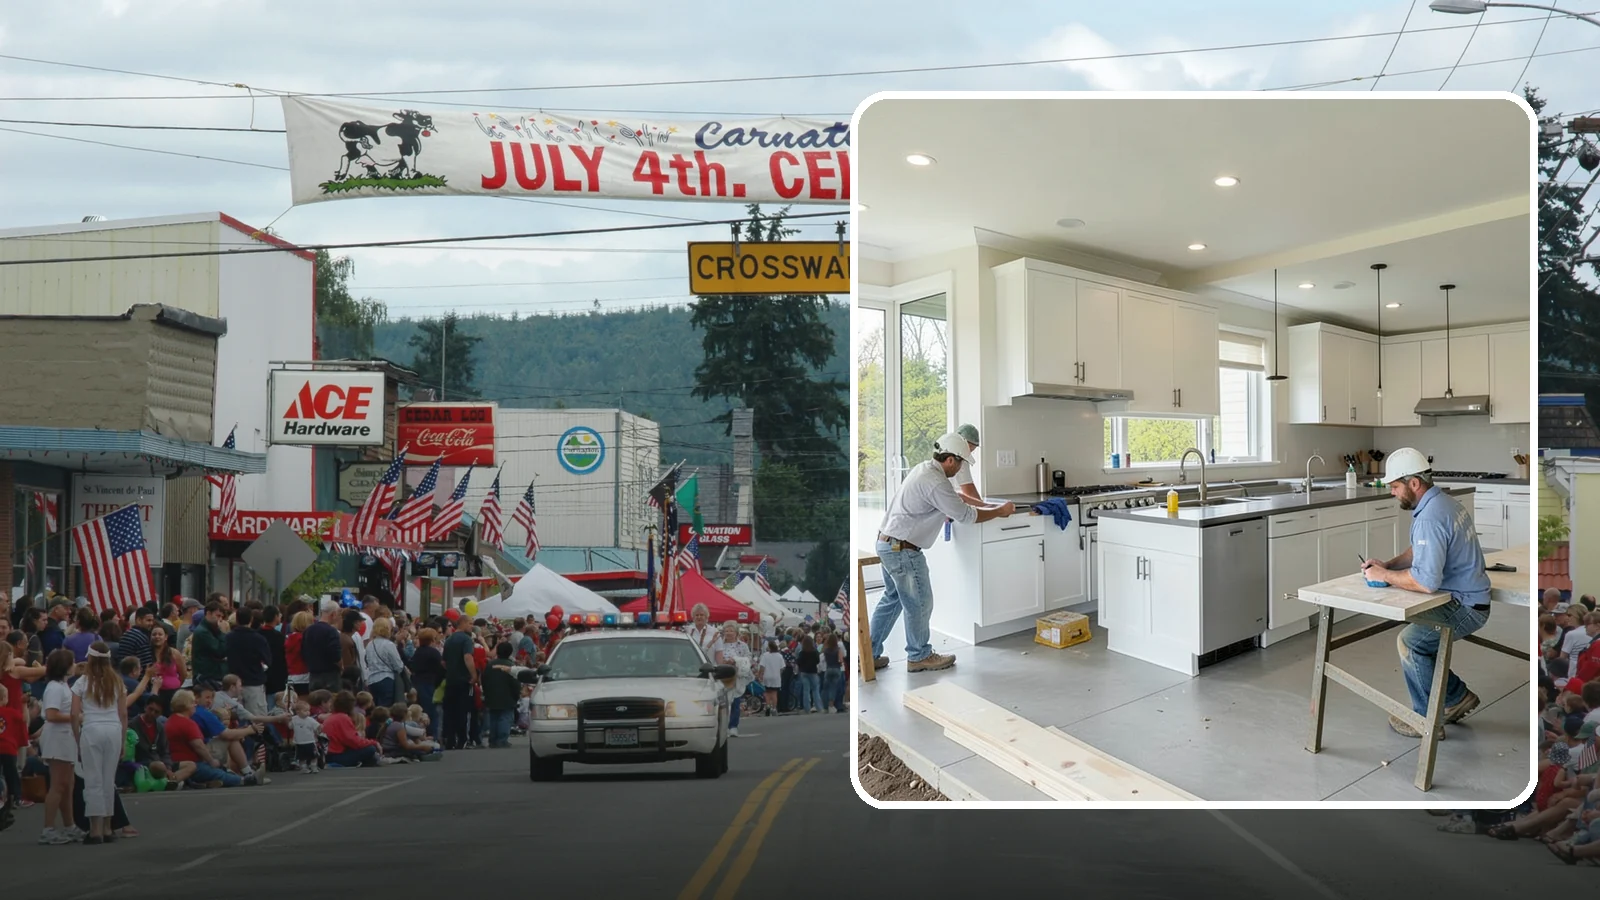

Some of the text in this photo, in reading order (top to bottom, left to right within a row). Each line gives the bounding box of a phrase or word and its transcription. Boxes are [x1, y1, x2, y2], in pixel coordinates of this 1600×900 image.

[481, 141, 604, 192] JULY
[632, 150, 746, 197] 4th.
[697, 254, 850, 280] CROSSWA
[283, 380, 373, 419] ACE
[406, 409, 485, 422] CEDAR LOG
[283, 421, 370, 436] Hardware
[416, 428, 477, 446] Coca-Cola
[354, 467, 385, 480] Simpl
[126, 486, 136, 494] de
[137, 486, 155, 495] Paul
[81, 503, 153, 521] THT
[212, 515, 330, 535] HARDARE
[699, 535, 730, 543] GLASS
